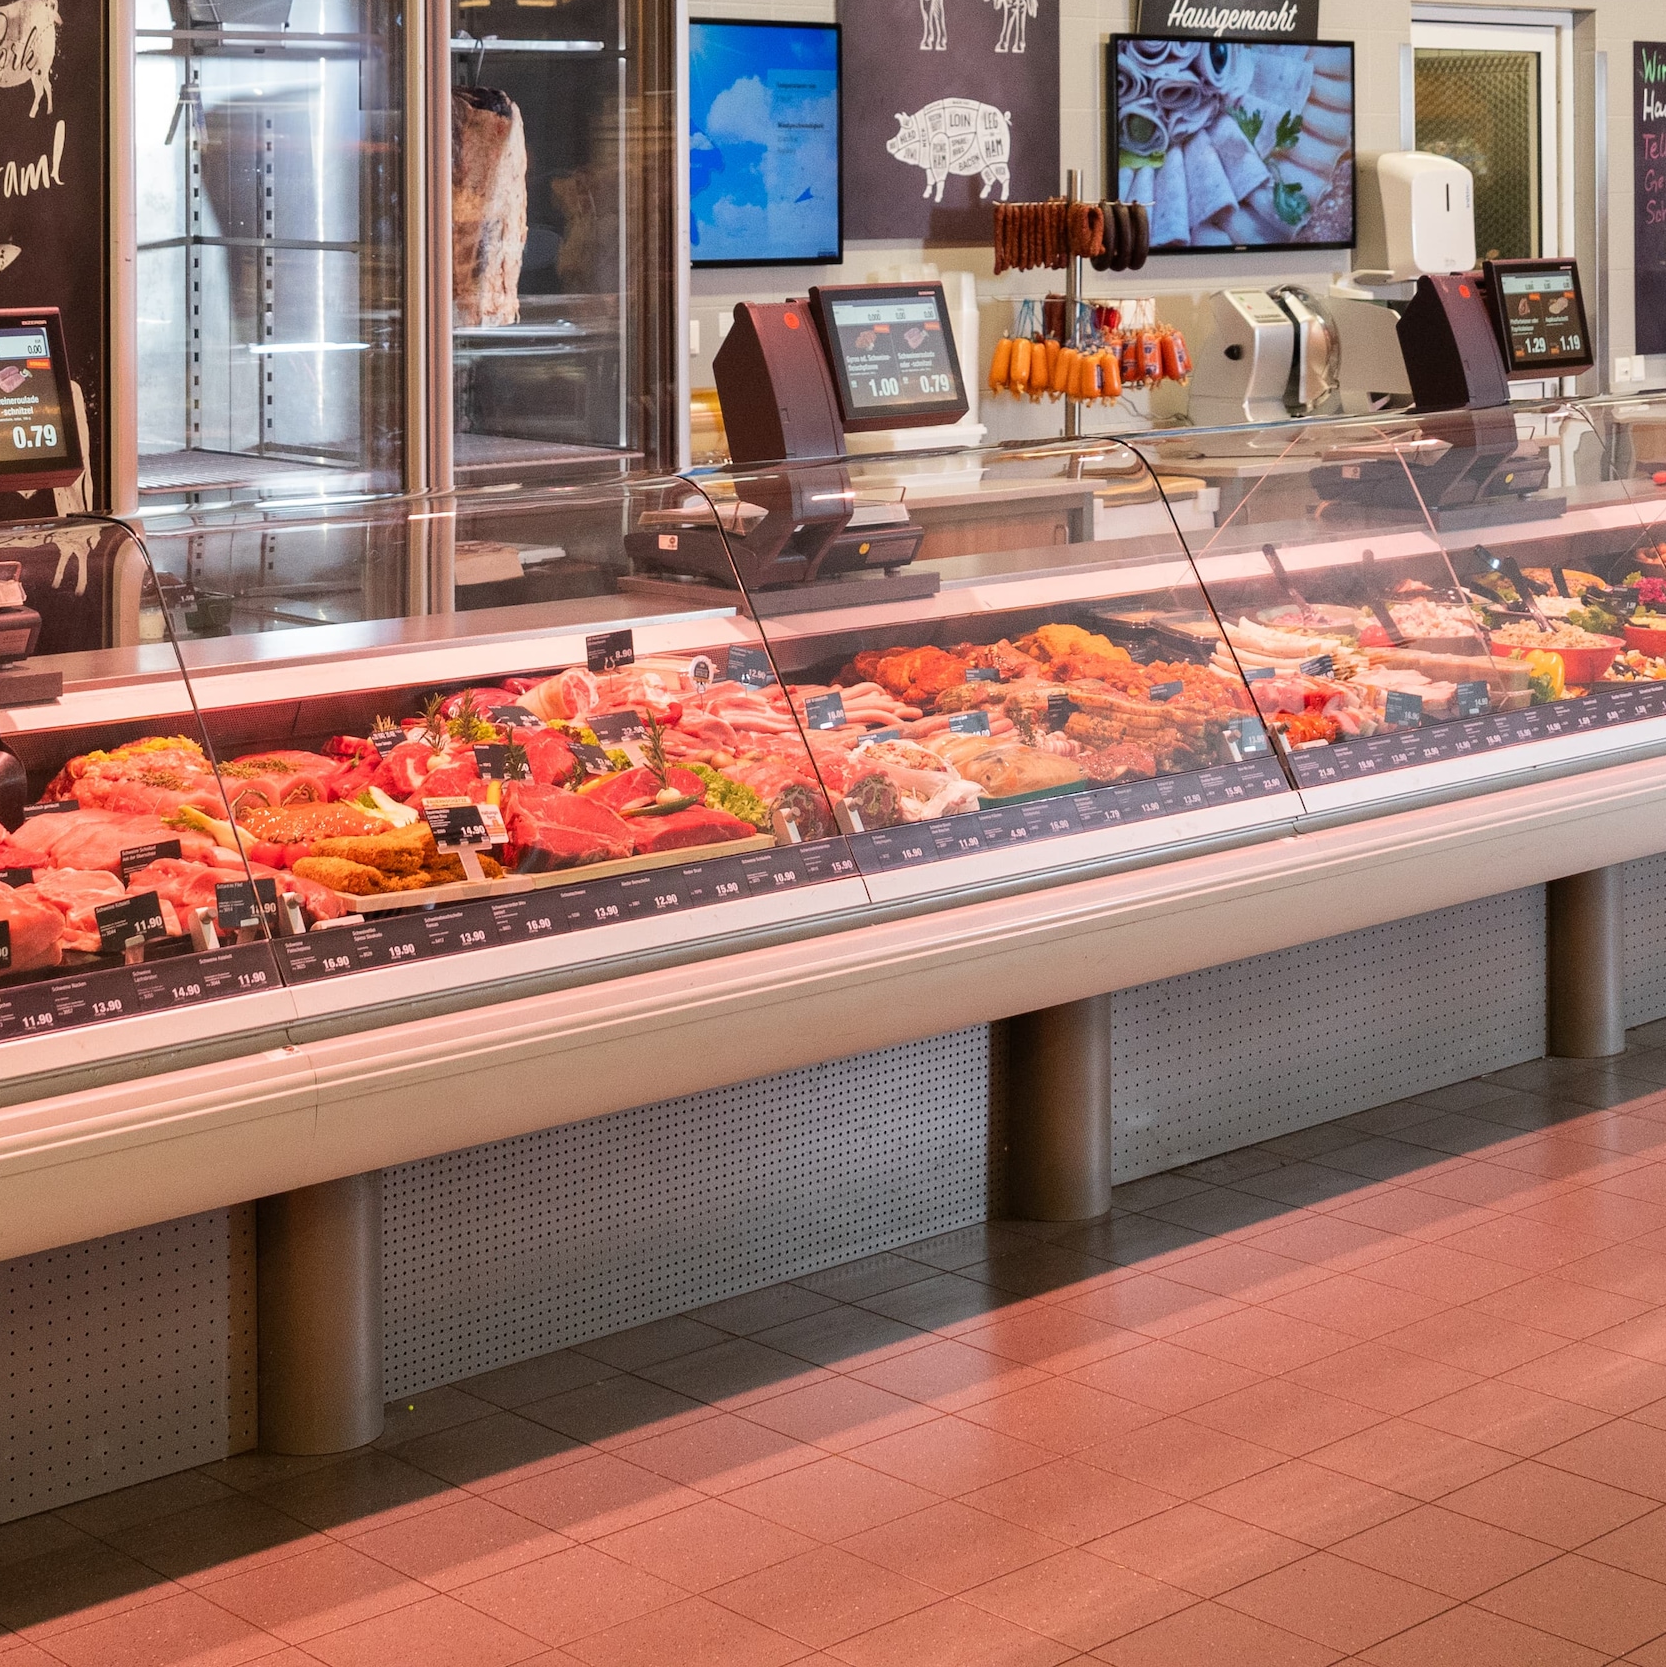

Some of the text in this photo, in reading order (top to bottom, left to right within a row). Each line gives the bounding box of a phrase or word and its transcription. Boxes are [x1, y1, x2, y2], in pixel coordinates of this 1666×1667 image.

[949, 113, 971, 127] LOIN
[983, 112, 998, 130] LEG
[985, 138, 1004, 159] HAM
[1525, 337, 1546, 353] 1.29
[1560, 334, 1581, 351] 1.19
[869, 377, 899, 397] 1.00
[920, 374, 950, 393] 0.79
[1, 406, 34, 416] -schnitzel
[12, 424, 58, 449] 0.79
[460, 825, 485, 835] 14.90
[1010, 827, 1027, 839] 4.90
[958, 836, 980, 850] 11.90
[901, 847, 923, 860] 16.90
[831, 859, 853, 873] 15.90
[773, 870, 795, 884] 10.90
[715, 882, 738, 896] 15.90
[654, 893, 678, 906] 12.90
[594, 904, 619, 918] 13.90
[134, 915, 163, 933] 11.90
[526, 917, 551, 931] 16.90
[459, 930, 486, 944] 13.90
[388, 943, 415, 957] 19.90
[322, 955, 350, 969] 16.90
[237, 970, 267, 987] 11.90
[171, 983, 201, 999] 14.90
[92, 998, 122, 1015] 13.90
[22, 1012, 53, 1029] 11.90
